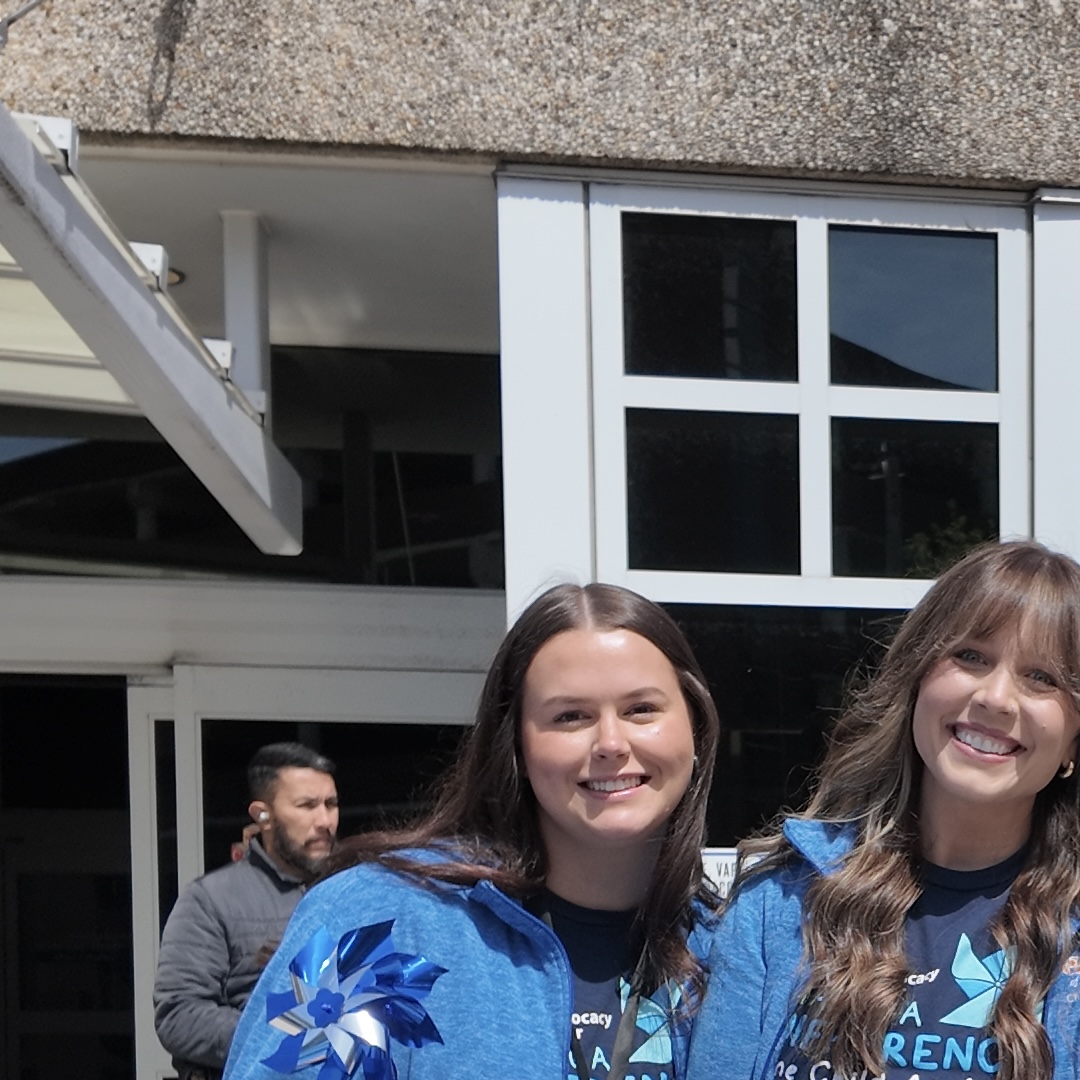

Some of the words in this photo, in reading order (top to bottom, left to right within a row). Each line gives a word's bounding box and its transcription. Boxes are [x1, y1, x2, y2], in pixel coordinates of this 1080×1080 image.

[571, 1012, 613, 1030] ocacy
[900, 1001, 922, 1027] A
[591, 1046, 611, 1072] A
